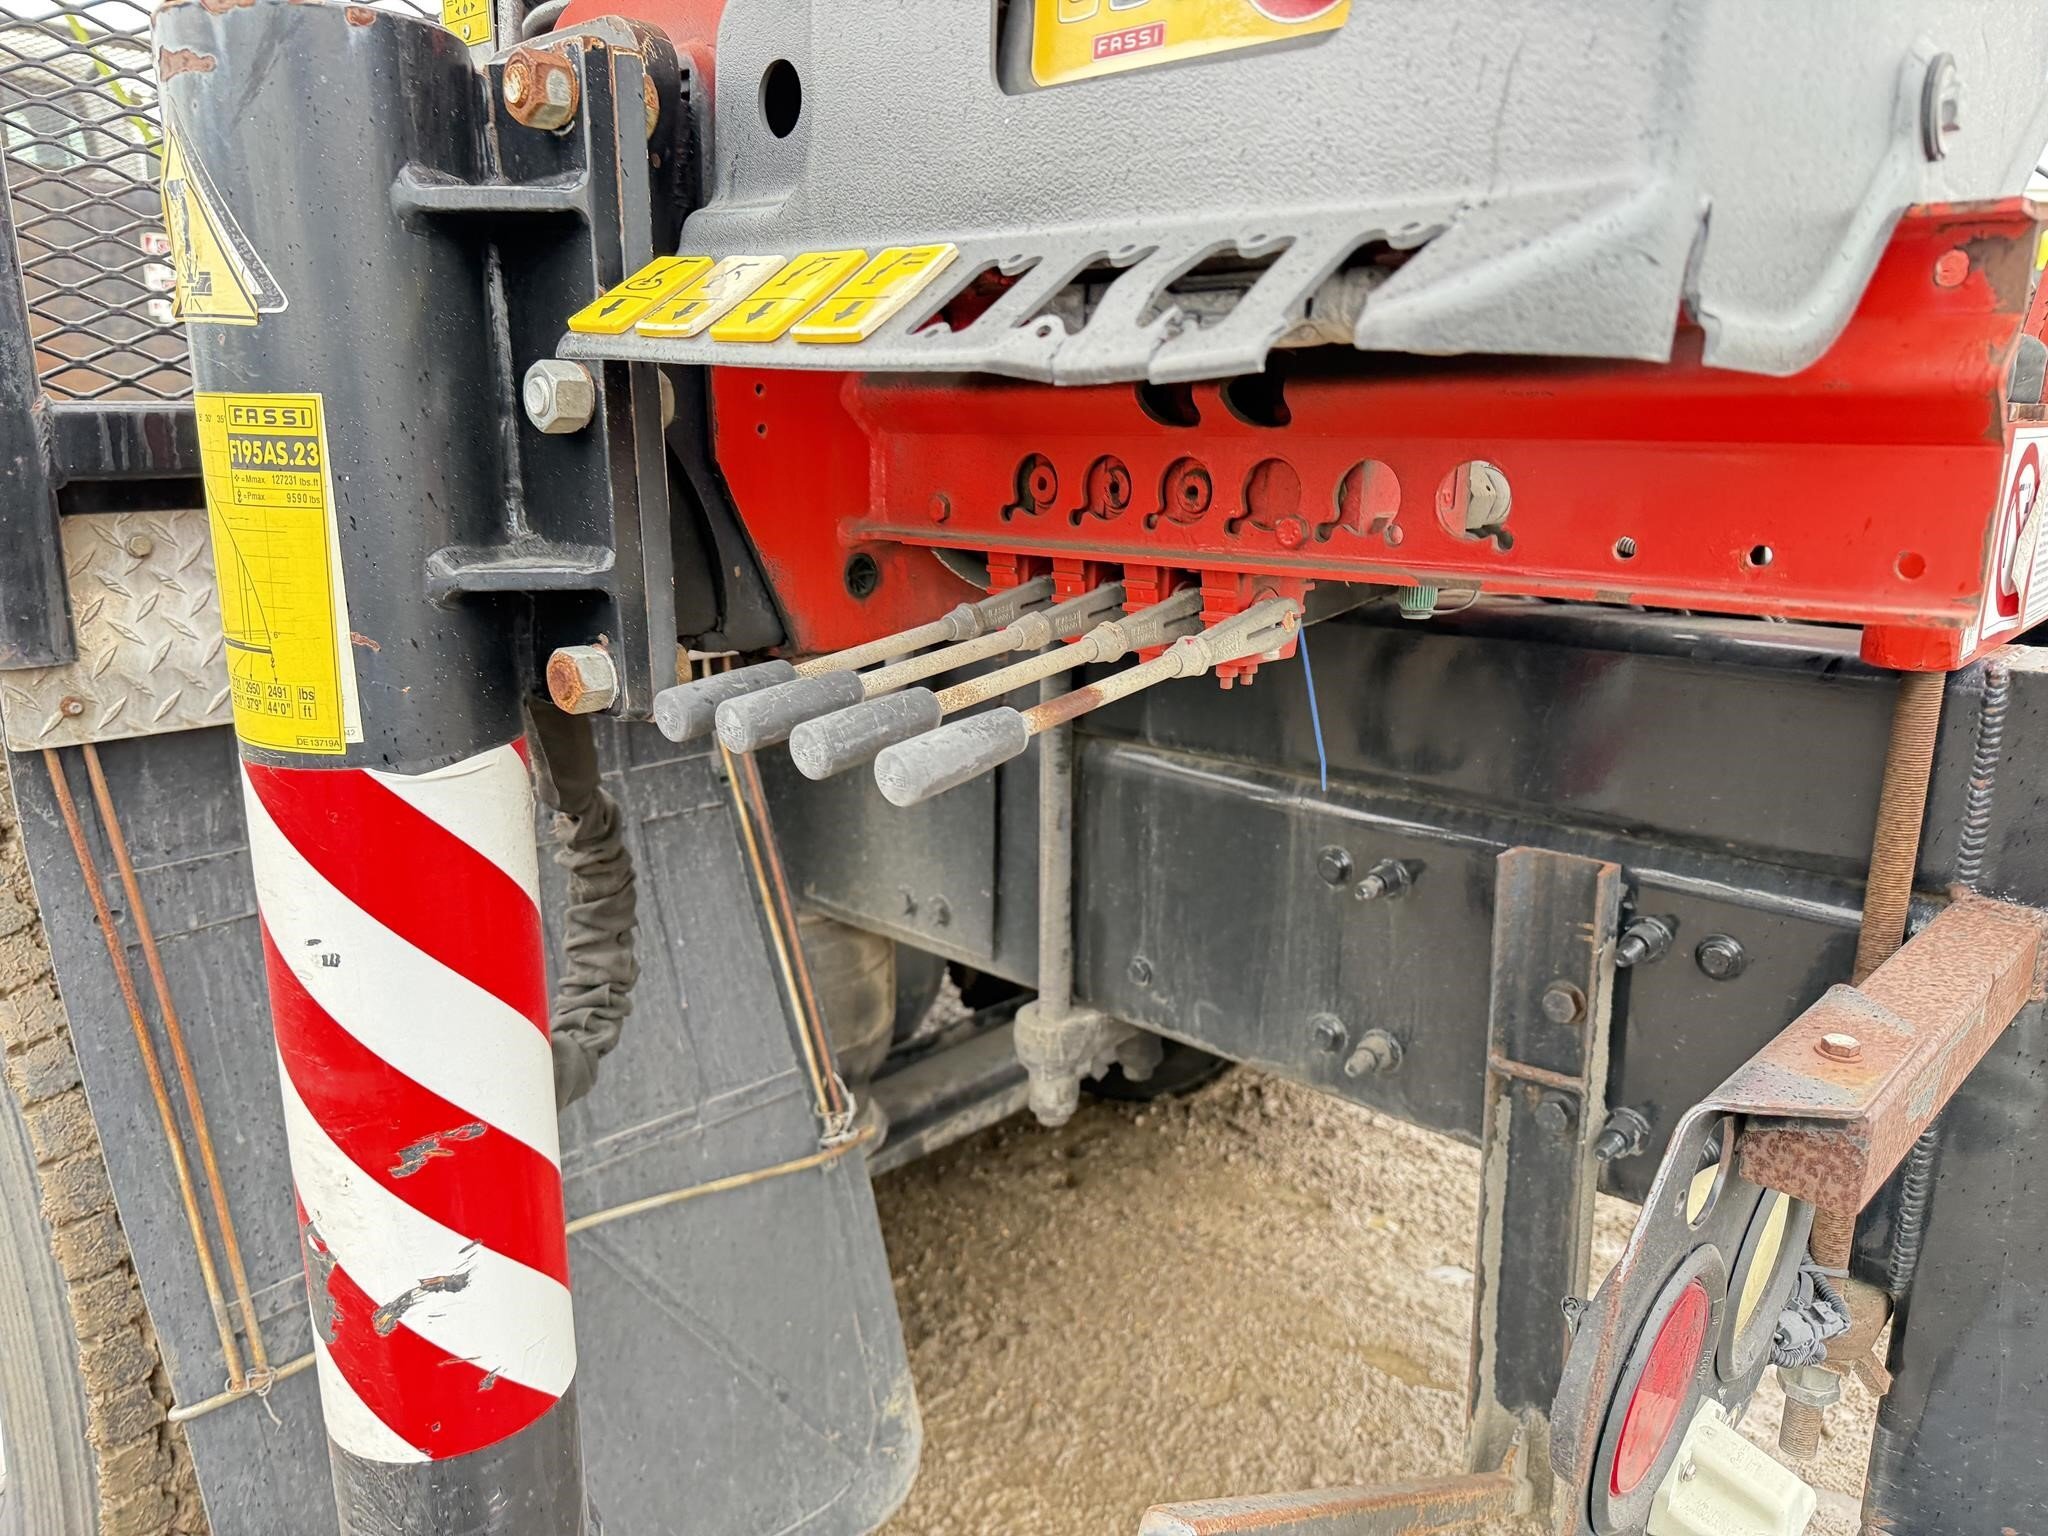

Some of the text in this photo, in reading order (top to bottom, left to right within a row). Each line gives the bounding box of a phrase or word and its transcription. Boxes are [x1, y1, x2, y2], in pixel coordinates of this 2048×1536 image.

[1096, 26, 1161, 56] FASSI
[233, 407, 306, 426] FASSI
[229, 439, 320, 467] F195AS.23
[271, 474, 297, 485] 127231
[286, 493, 308, 504] 9590
[309, 495, 321, 504] lbs
[245, 681, 261, 695] 2950
[268, 685, 287, 699] 2491
[298, 687, 315, 701] lbs
[267, 702, 291, 716] 44'0"
[303, 704, 312, 718] ft
[311, 739, 340, 747] 13719A
